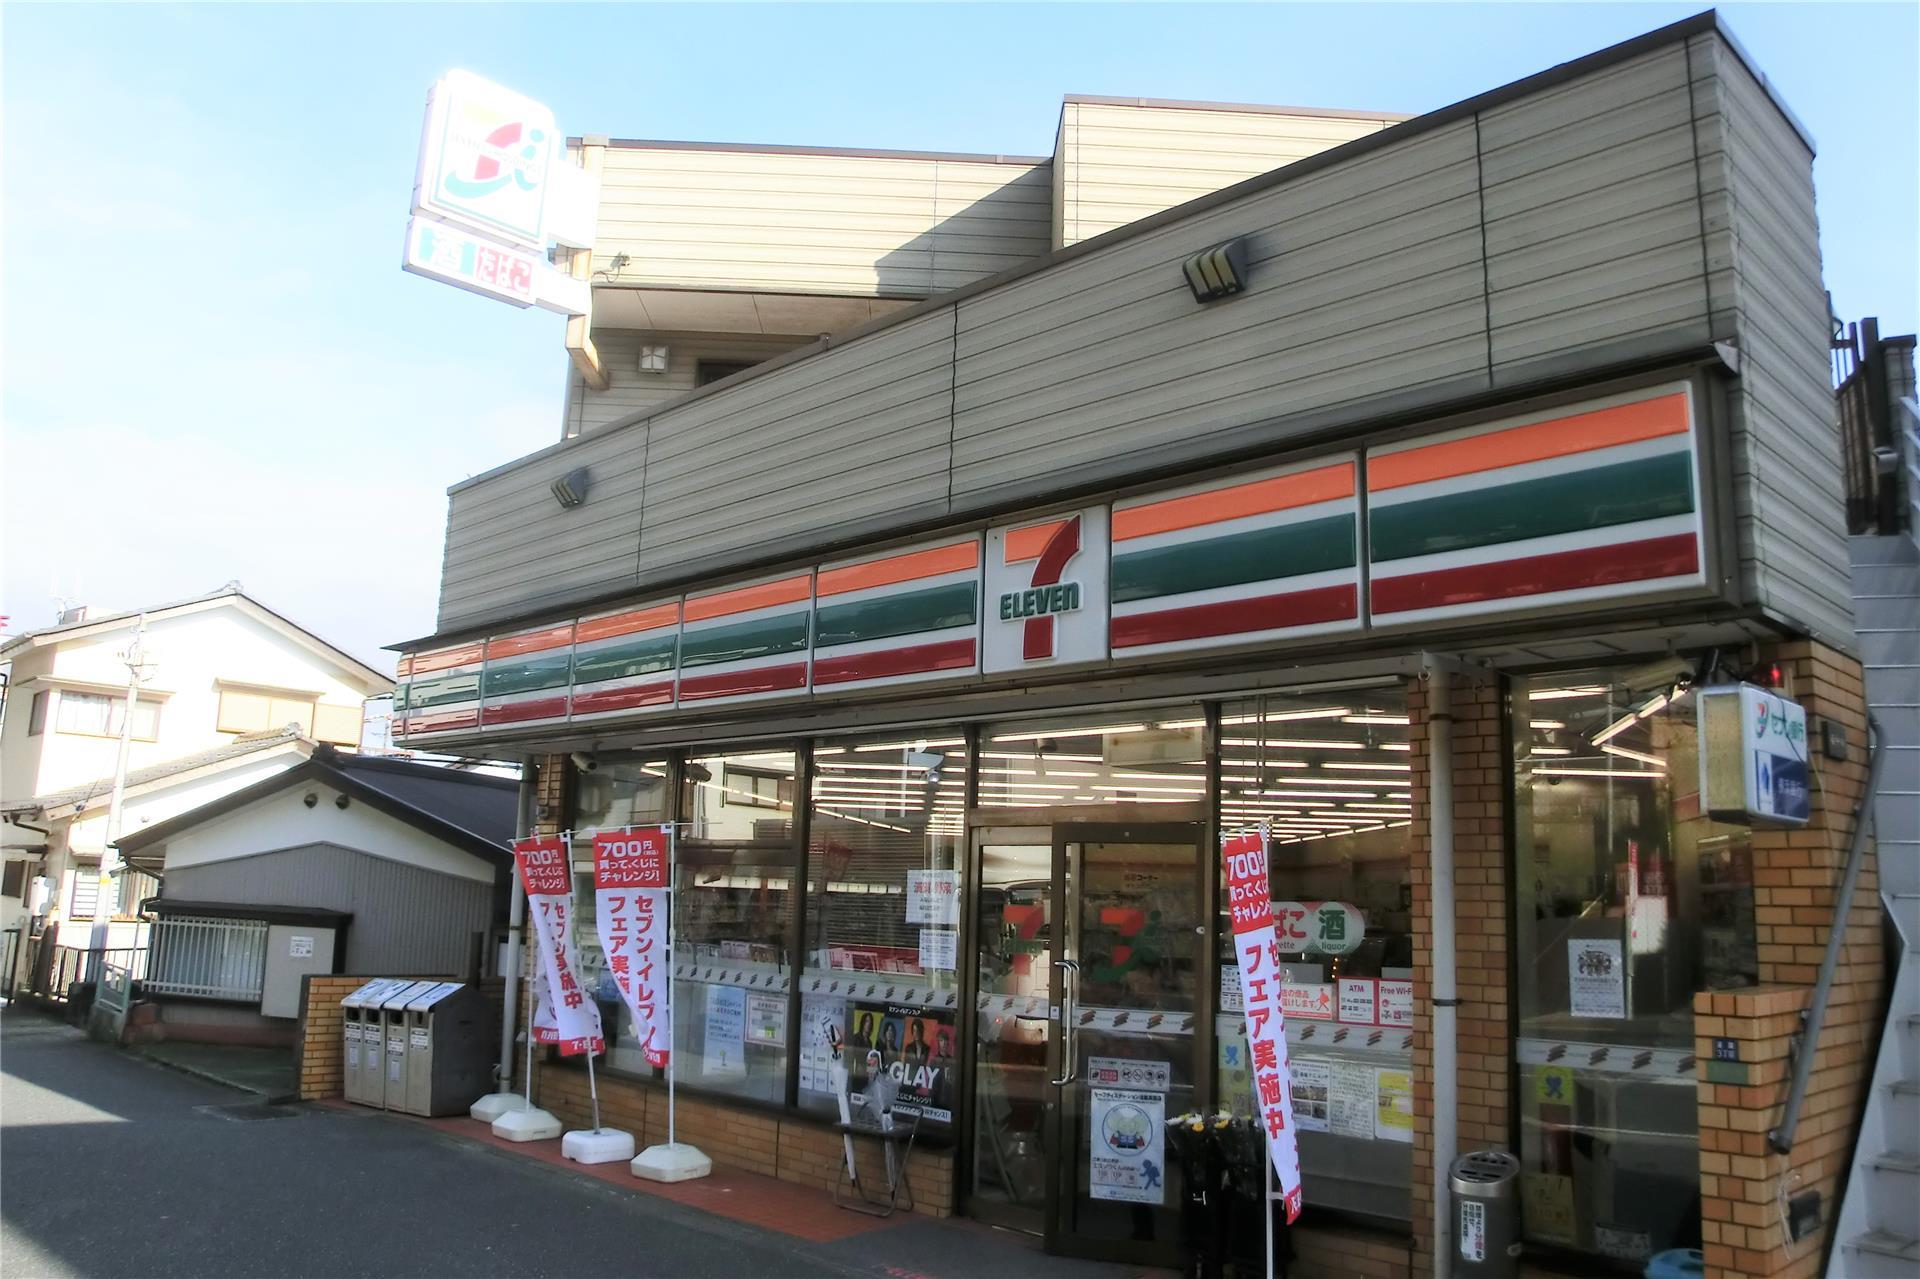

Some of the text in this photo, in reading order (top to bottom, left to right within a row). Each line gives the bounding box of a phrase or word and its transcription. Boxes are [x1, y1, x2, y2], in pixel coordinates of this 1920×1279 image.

[479, 247, 531, 294] たばこ
[1319, 909, 1346, 940] 酒
[1321, 942, 1346, 955] liquor
[1381, 986, 1395, 994] Free
[889, 1060, 940, 1090] GLAY
